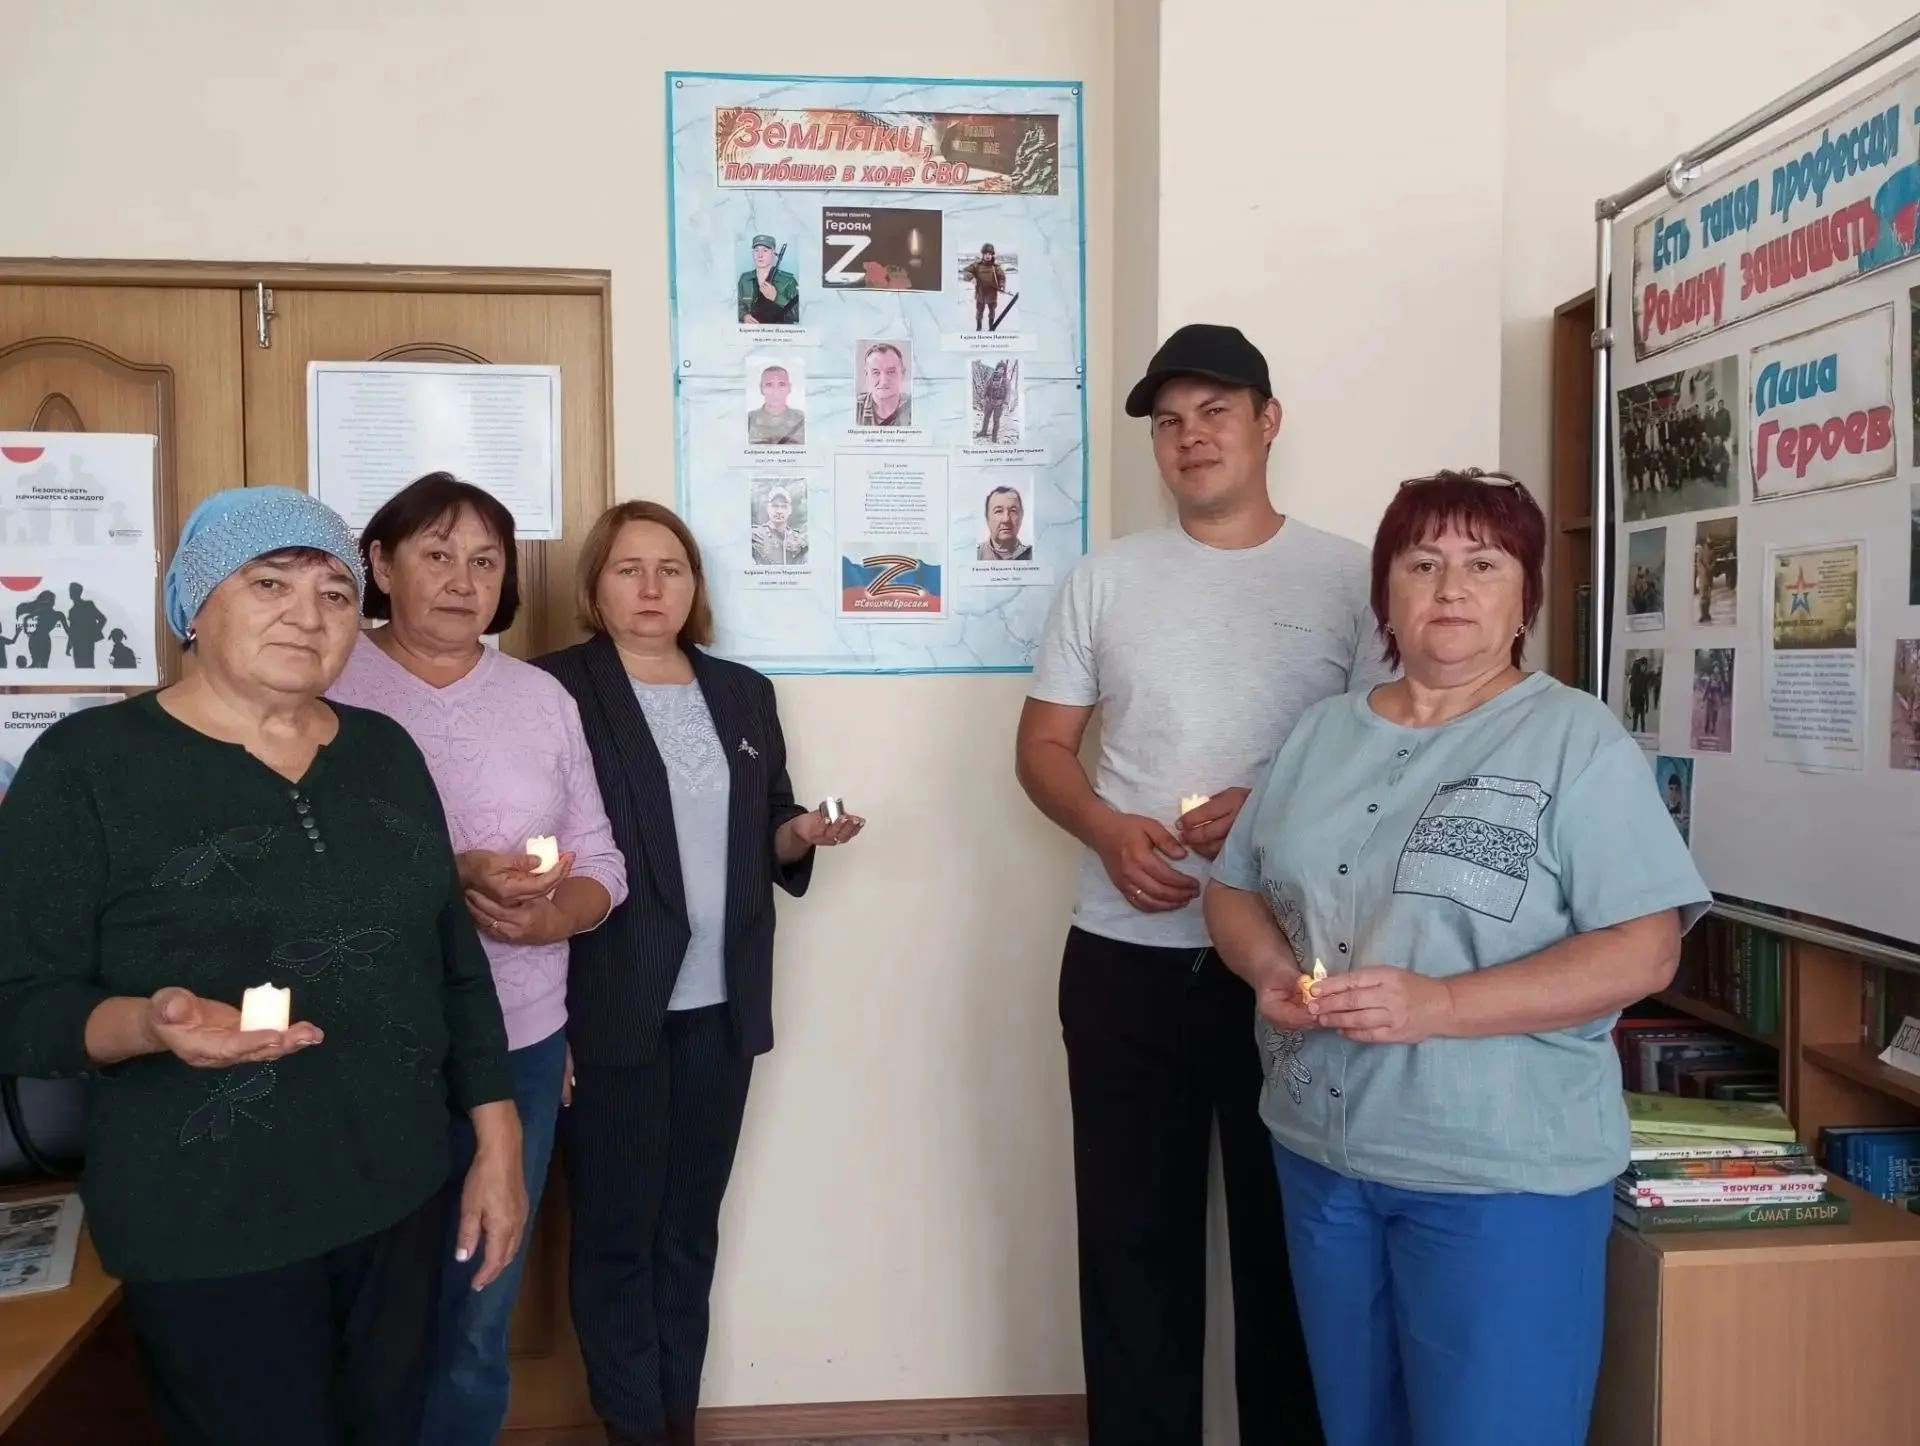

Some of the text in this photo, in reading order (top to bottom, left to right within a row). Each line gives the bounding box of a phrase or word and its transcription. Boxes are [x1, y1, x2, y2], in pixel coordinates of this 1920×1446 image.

[734, 110, 933, 162] Земляки,
[724, 157, 970, 187] погибшие в ходе СВО
[1653, 103, 1899, 273] Есть такая профессия
[825, 219, 872, 232] Героям
[825, 234, 872, 283] Z
[1642, 262, 1725, 342] Родину
[1756, 405, 1892, 480] Героев
[32, 485, 88, 494] Безопасность
[4, 721, 54, 729] Беспилот
[11, 711, 57, 720] Вступай
[1748, 1207, 1792, 1223] САМАТ
[1795, 1205, 1839, 1220] БАТЫР
